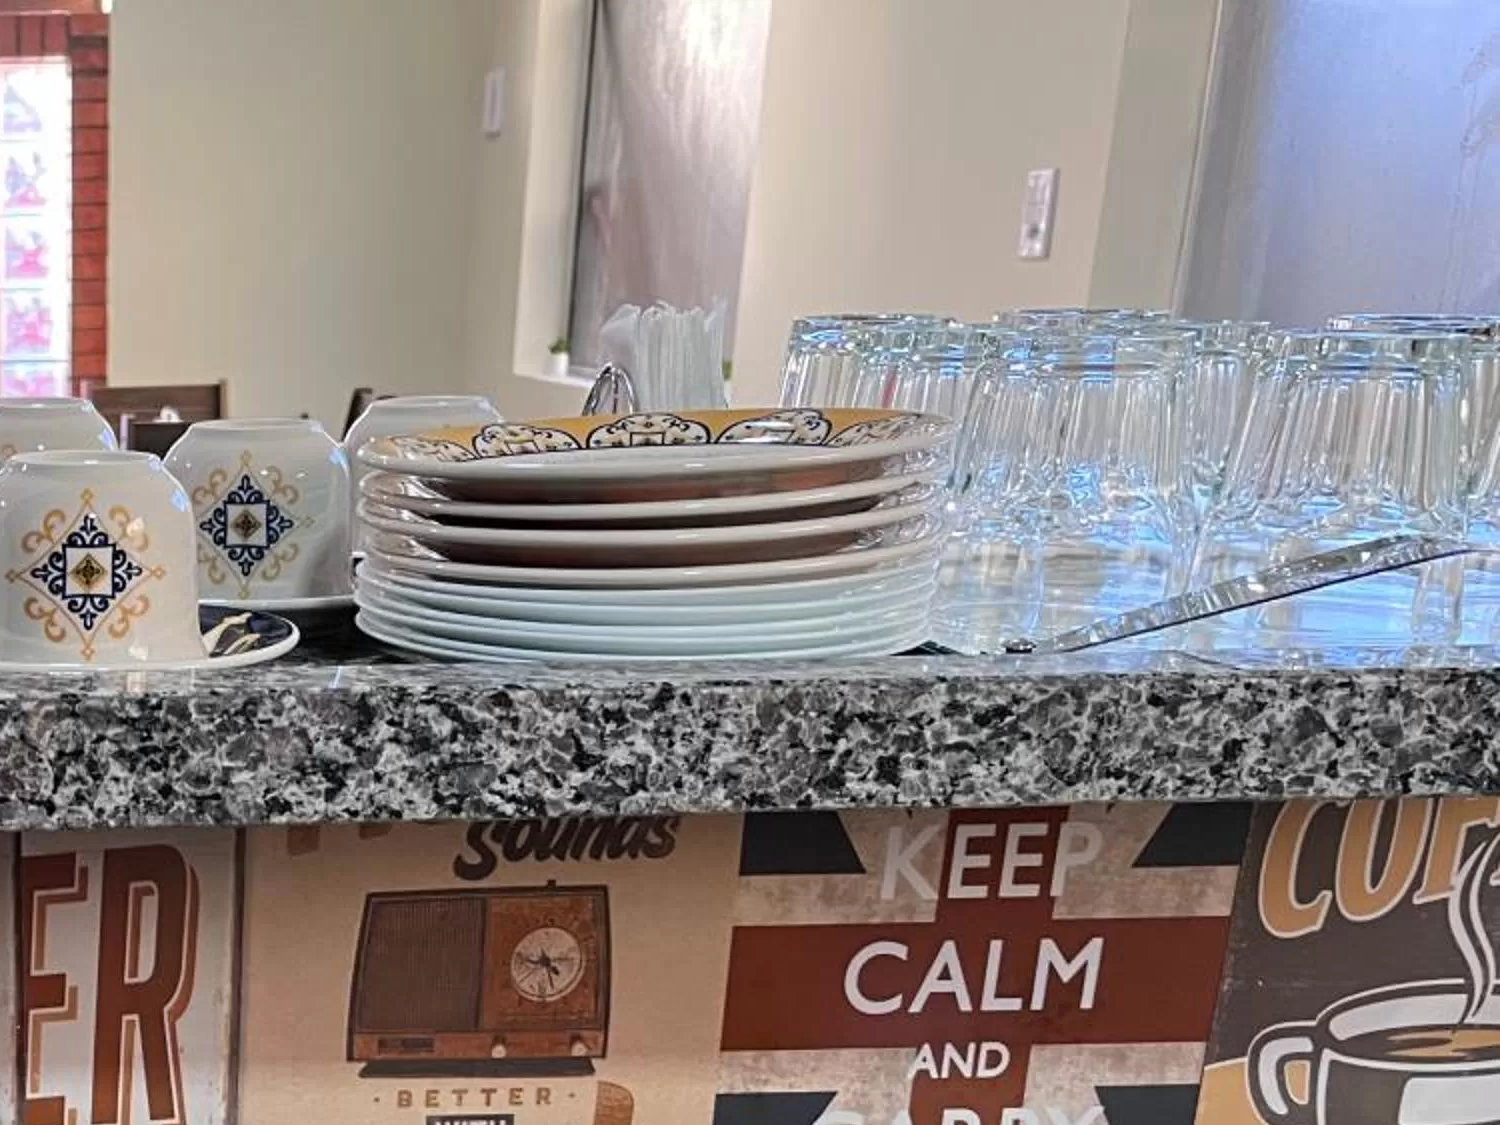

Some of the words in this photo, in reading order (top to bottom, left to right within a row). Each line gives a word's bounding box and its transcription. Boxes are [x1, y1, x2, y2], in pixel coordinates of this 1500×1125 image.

[878, 820, 1104, 901] KEEP
[844, 936, 1104, 1015] CALM
[907, 1041, 1011, 1080] AND
[396, 1087, 553, 1110] BETTER
